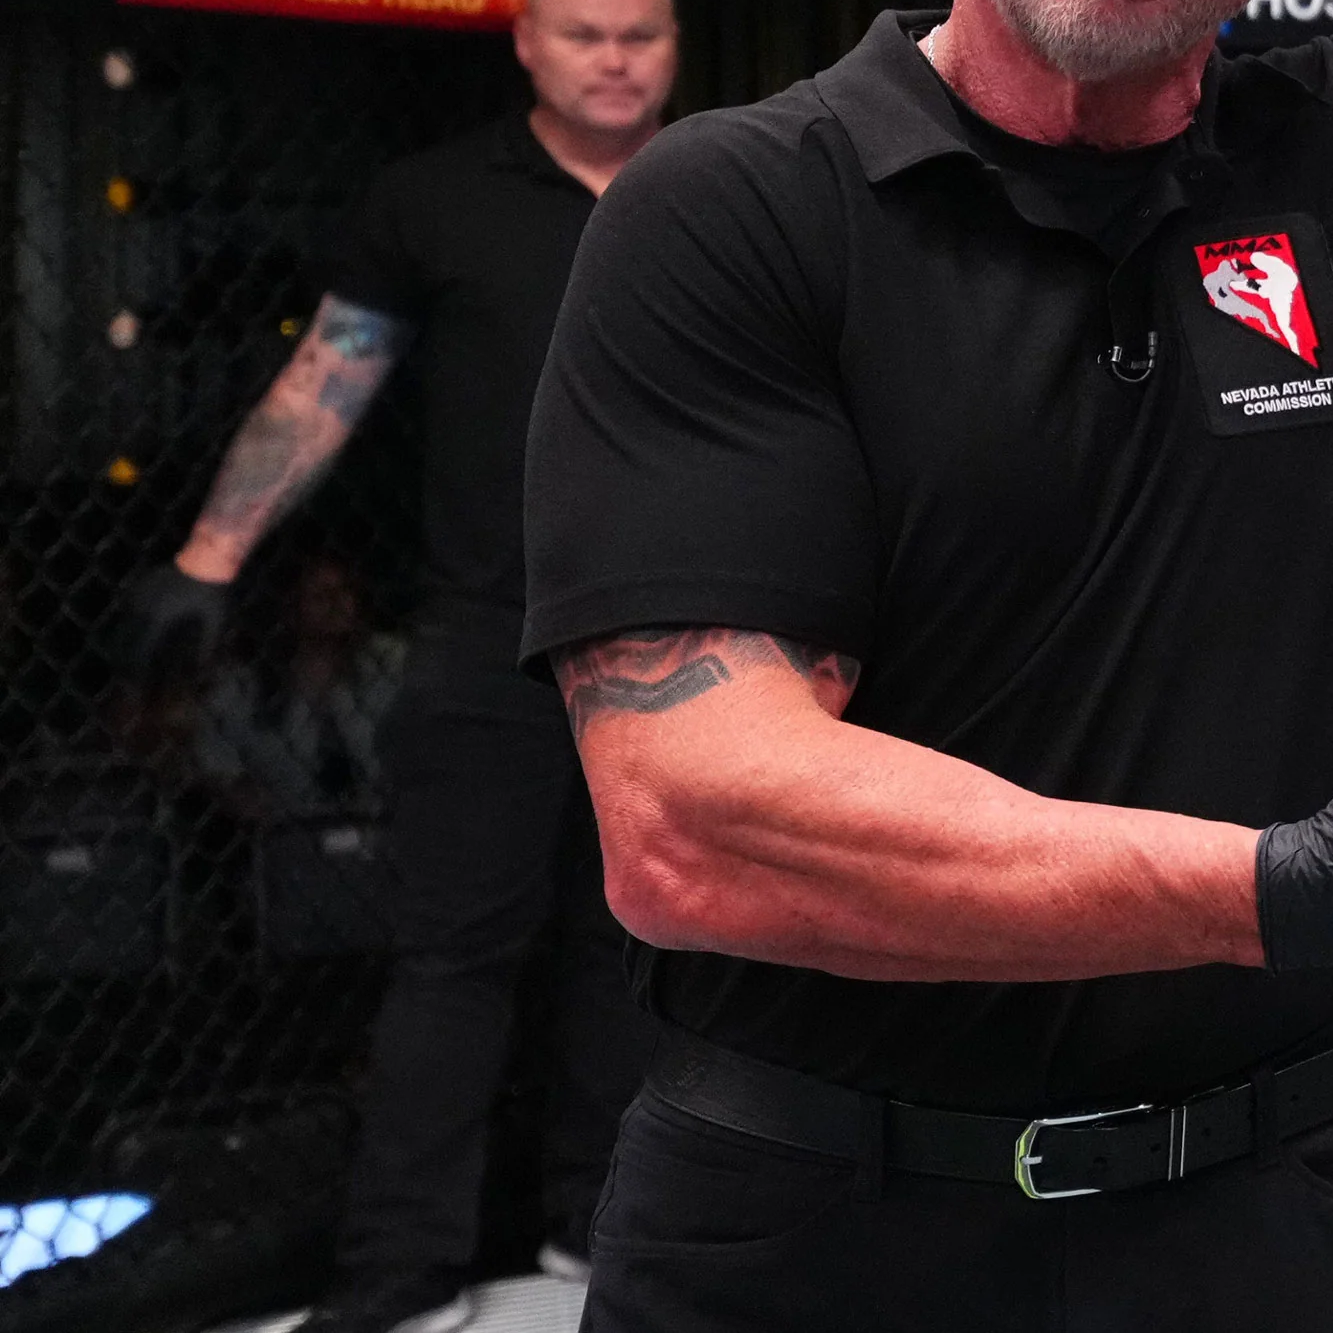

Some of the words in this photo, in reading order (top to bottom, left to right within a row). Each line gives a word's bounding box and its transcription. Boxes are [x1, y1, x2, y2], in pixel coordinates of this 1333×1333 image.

[1204, 237, 1282, 259] MMA
[1221, 384, 1281, 405] NEVADA
[1243, 392, 1333, 416] COMMISSION
